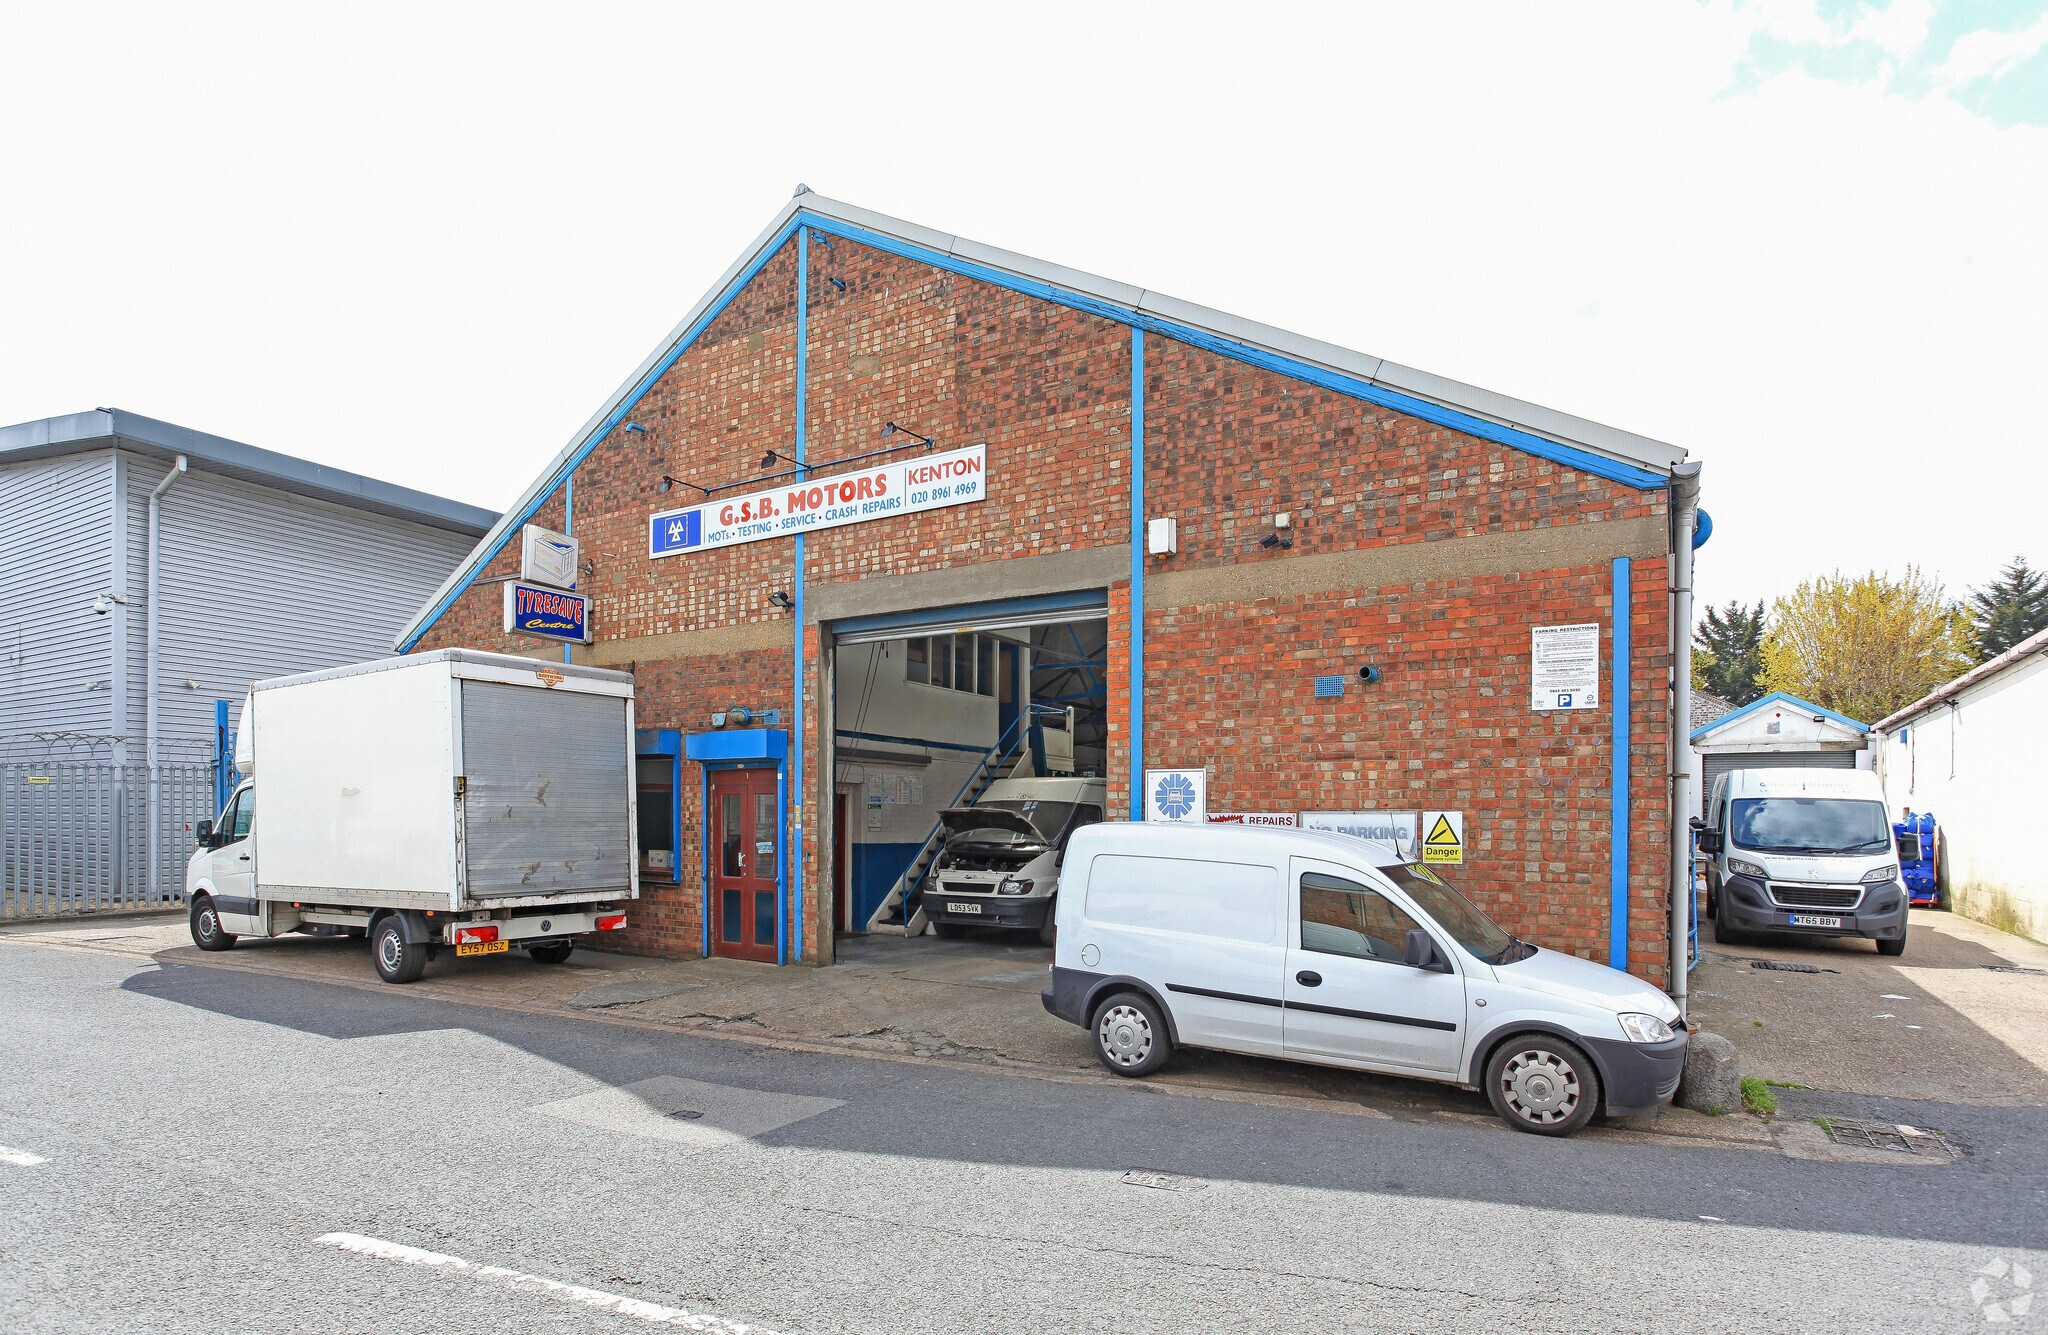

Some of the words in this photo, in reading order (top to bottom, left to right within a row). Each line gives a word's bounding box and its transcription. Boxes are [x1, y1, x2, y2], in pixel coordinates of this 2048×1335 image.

[909, 456, 981, 486] KENTON
[719, 497, 780, 527] G.S.B.
[787, 473, 887, 514] MOTORS
[911, 490, 928, 505] 020
[932, 486, 951, 501] 8961
[954, 481, 977, 496] 4969
[737, 521, 772, 538] TESTING
[781, 513, 816, 530] SERVICE
[825, 504, 858, 521] CRASH
[862, 496, 901, 515] REPAIRS
[518, 589, 583, 625] TYRESAVE
[525, 618, 575, 630] Centre
[1249, 816, 1293, 826] REPAIRS
[1426, 847, 1459, 858] Danger
[461, 943, 485, 954] EY57
